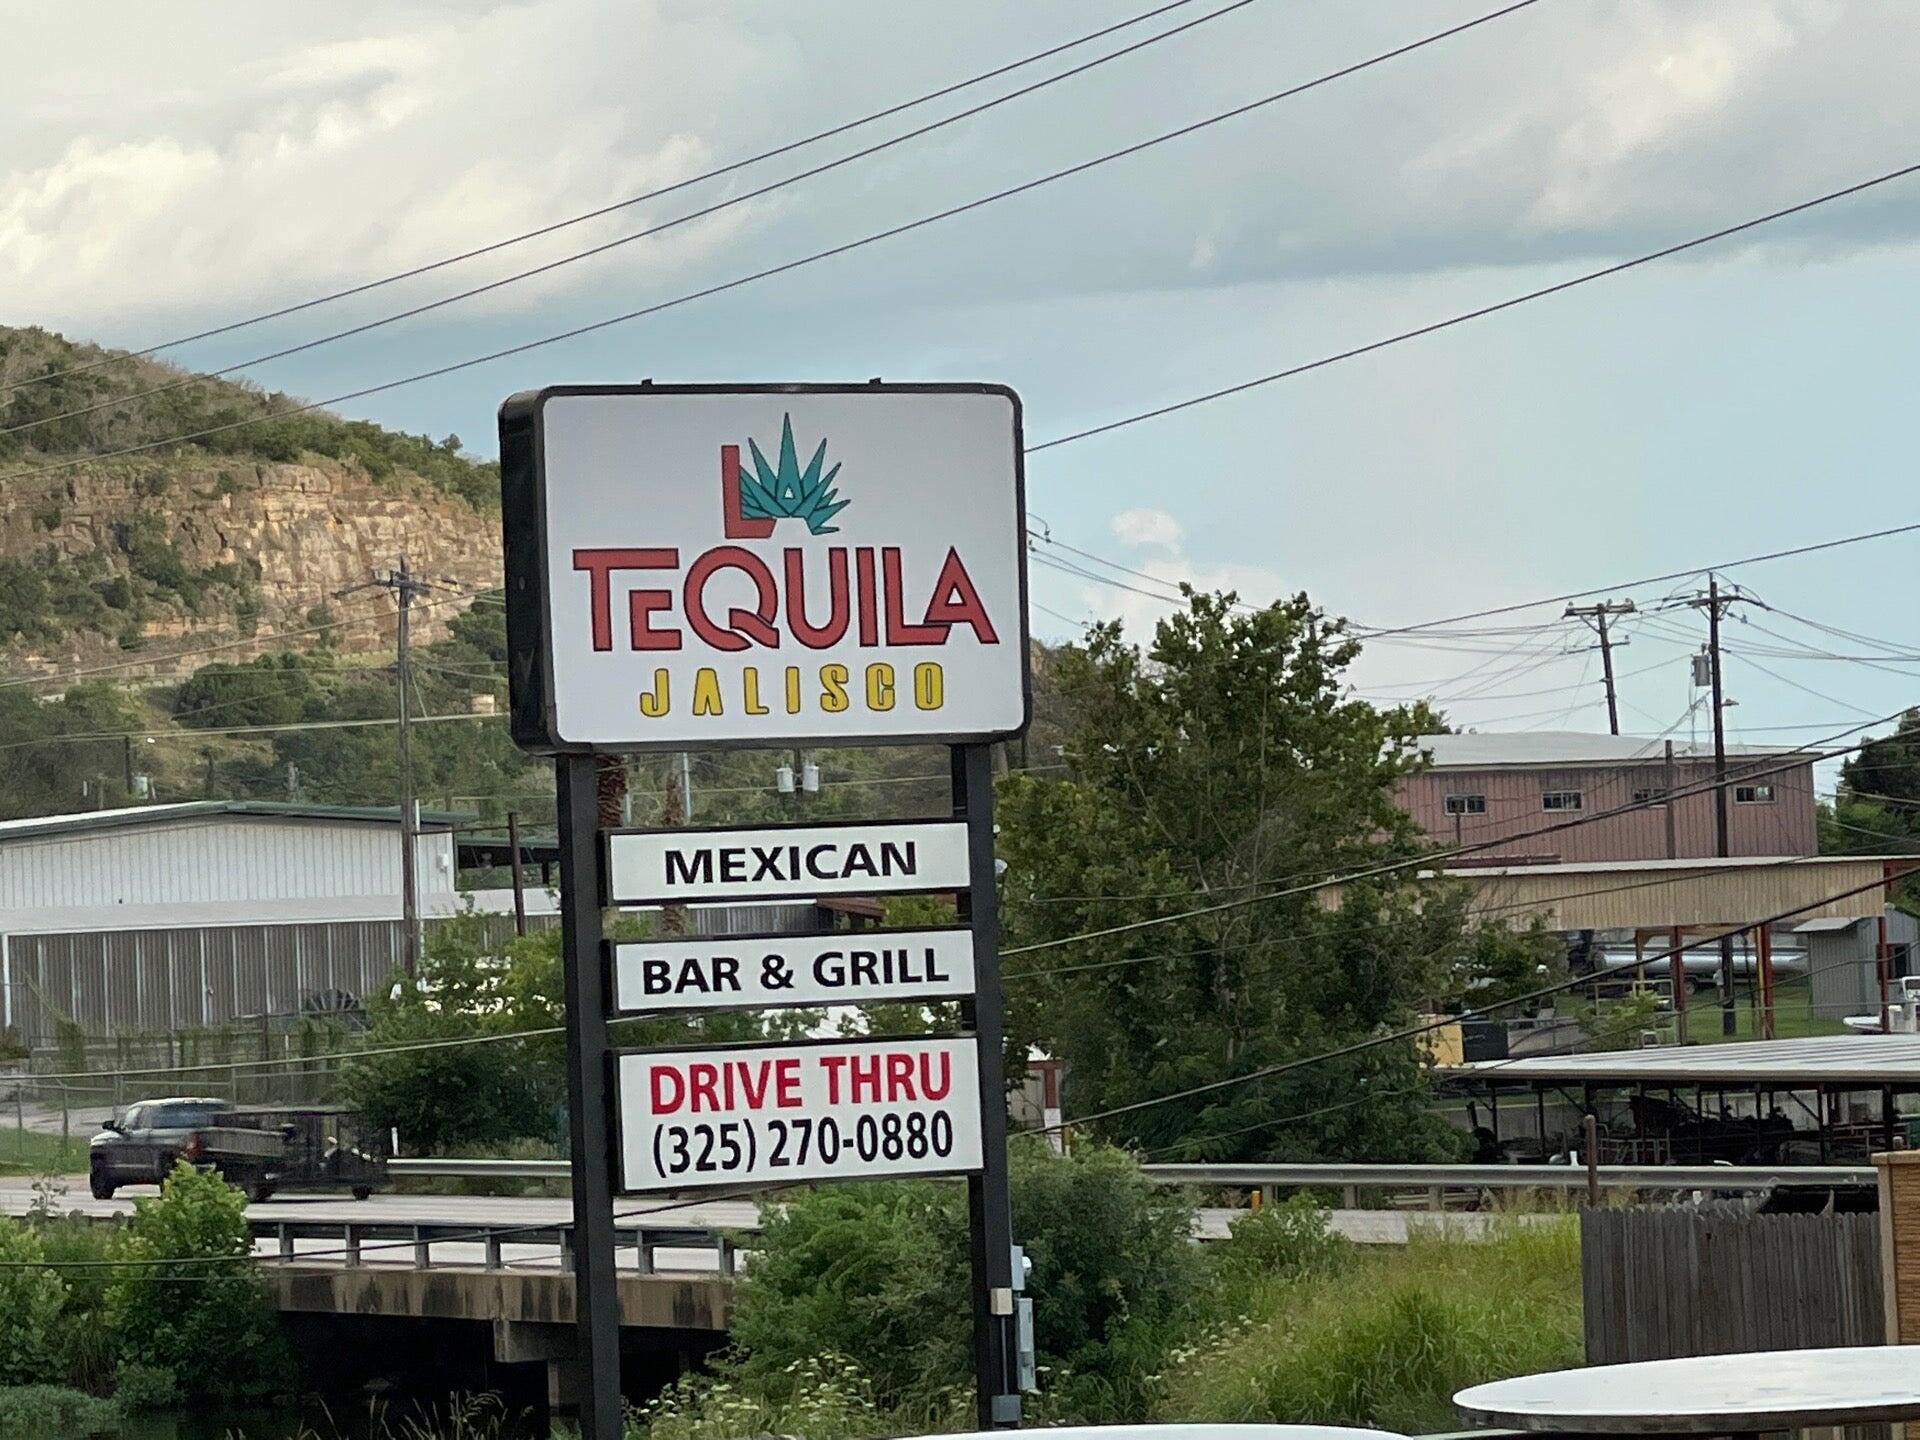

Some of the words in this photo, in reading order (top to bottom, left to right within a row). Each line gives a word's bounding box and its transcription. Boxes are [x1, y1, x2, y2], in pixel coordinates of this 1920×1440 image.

[572, 545, 1001, 652] TEQUILA
[639, 662, 944, 718] JALISCO
[664, 841, 918, 885] MEXICAN
[641, 956, 742, 995] BAR
[759, 953, 795, 990] &
[812, 947, 950, 988] GRILL
[649, 1058, 803, 1115] DRIVE
[819, 1051, 952, 1104] THRU
[652, 1117, 757, 1179] (325)
[767, 1109, 954, 1167] 270-0880
